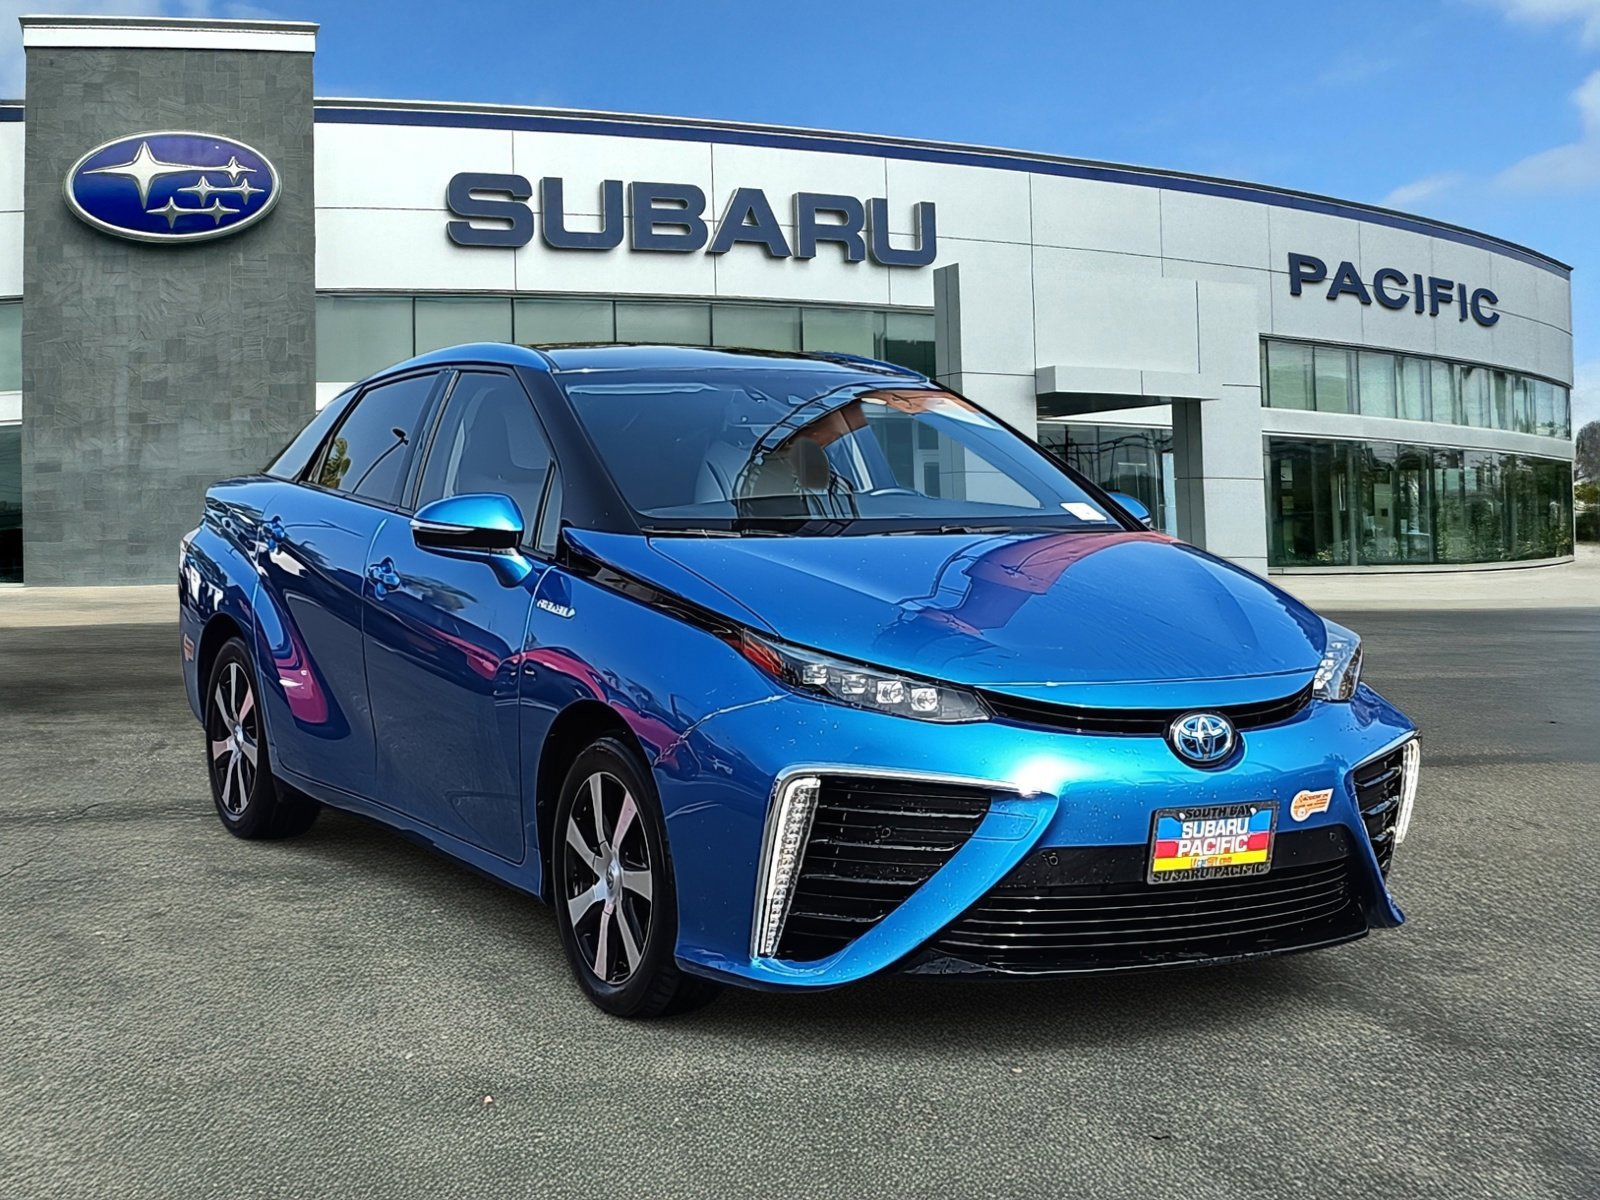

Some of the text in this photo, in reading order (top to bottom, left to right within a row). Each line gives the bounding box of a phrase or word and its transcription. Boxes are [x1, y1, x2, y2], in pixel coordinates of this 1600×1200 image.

[446, 171, 937, 268] SUBARU
[1288, 252, 1501, 327] PACIFIC
[1185, 807, 1227, 819] SOUTH
[1181, 817, 1250, 839] SUBARU
[1177, 836, 1249, 857] PACIFIC
[1152, 868, 1210, 882] SUBARU
